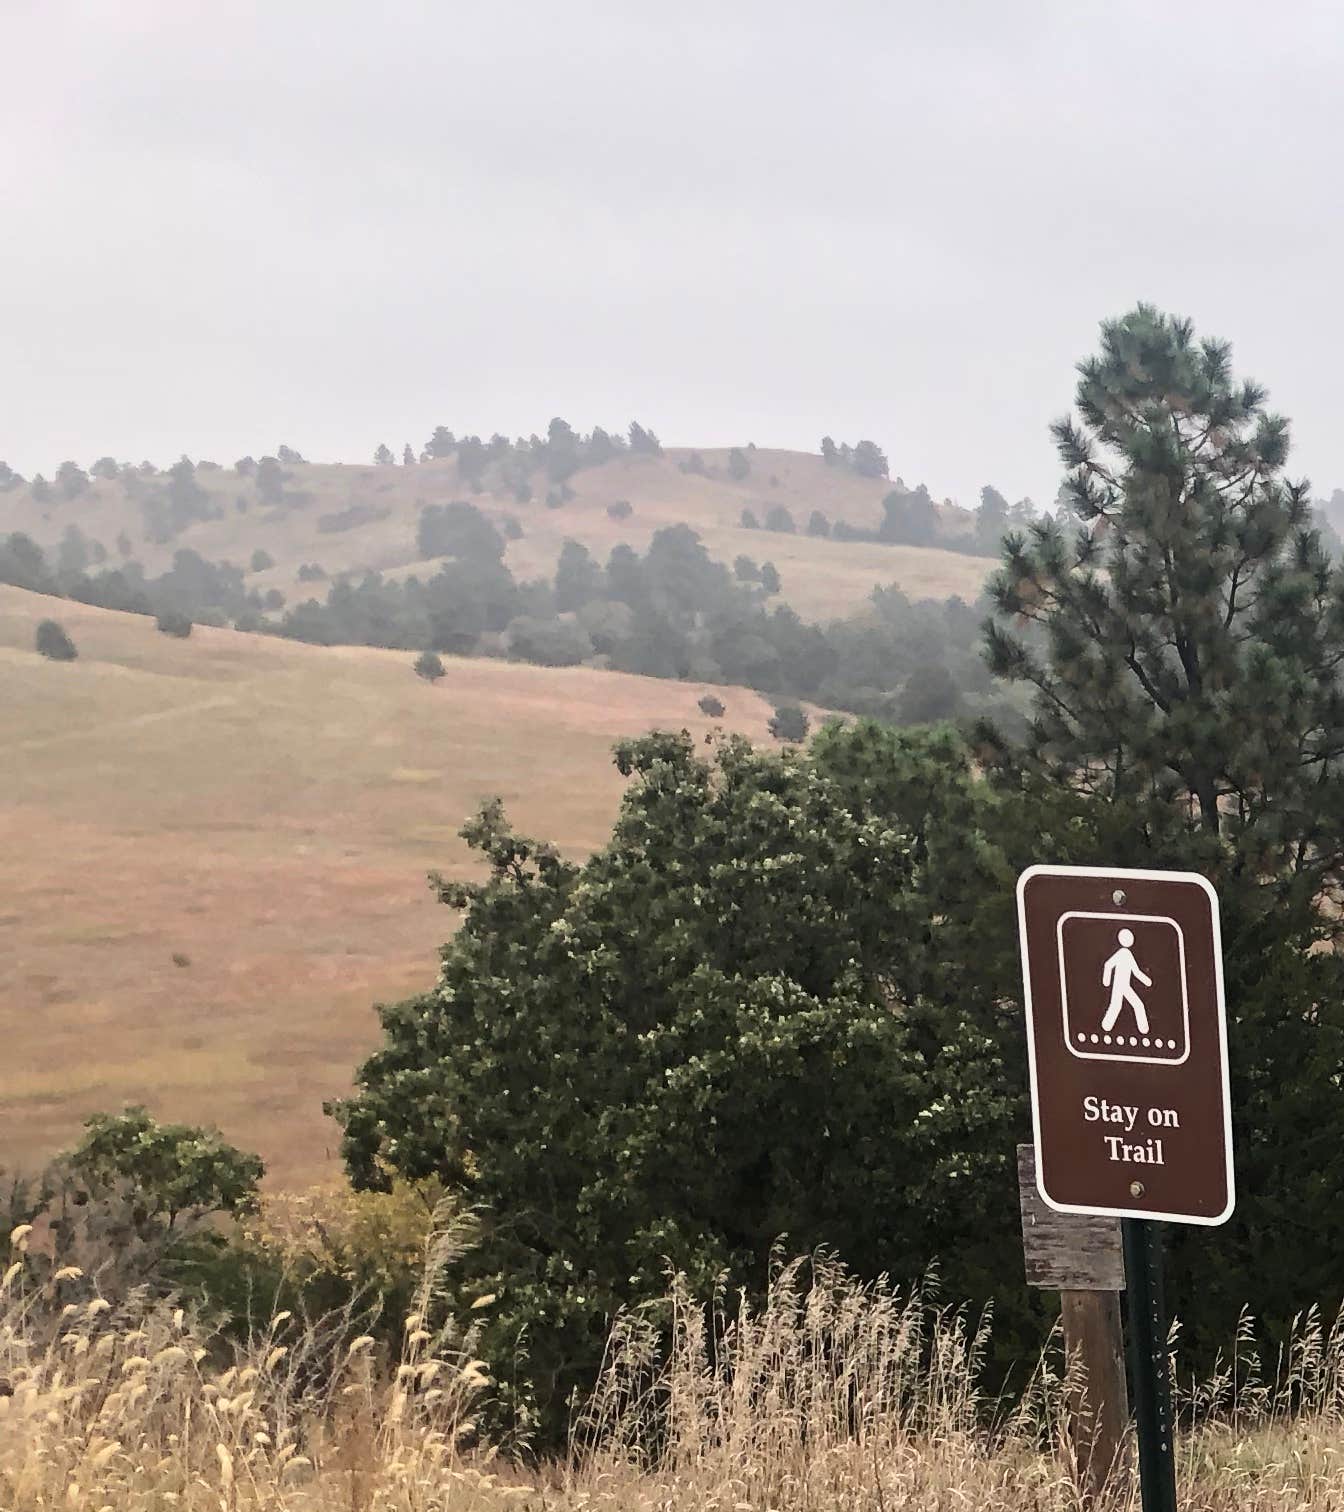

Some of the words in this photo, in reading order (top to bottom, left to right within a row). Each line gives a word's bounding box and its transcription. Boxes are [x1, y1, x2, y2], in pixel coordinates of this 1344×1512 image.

[1083, 1096, 1139, 1131] Stay
[1147, 1105, 1180, 1128] on
[1104, 1136, 1165, 1165] Trail
